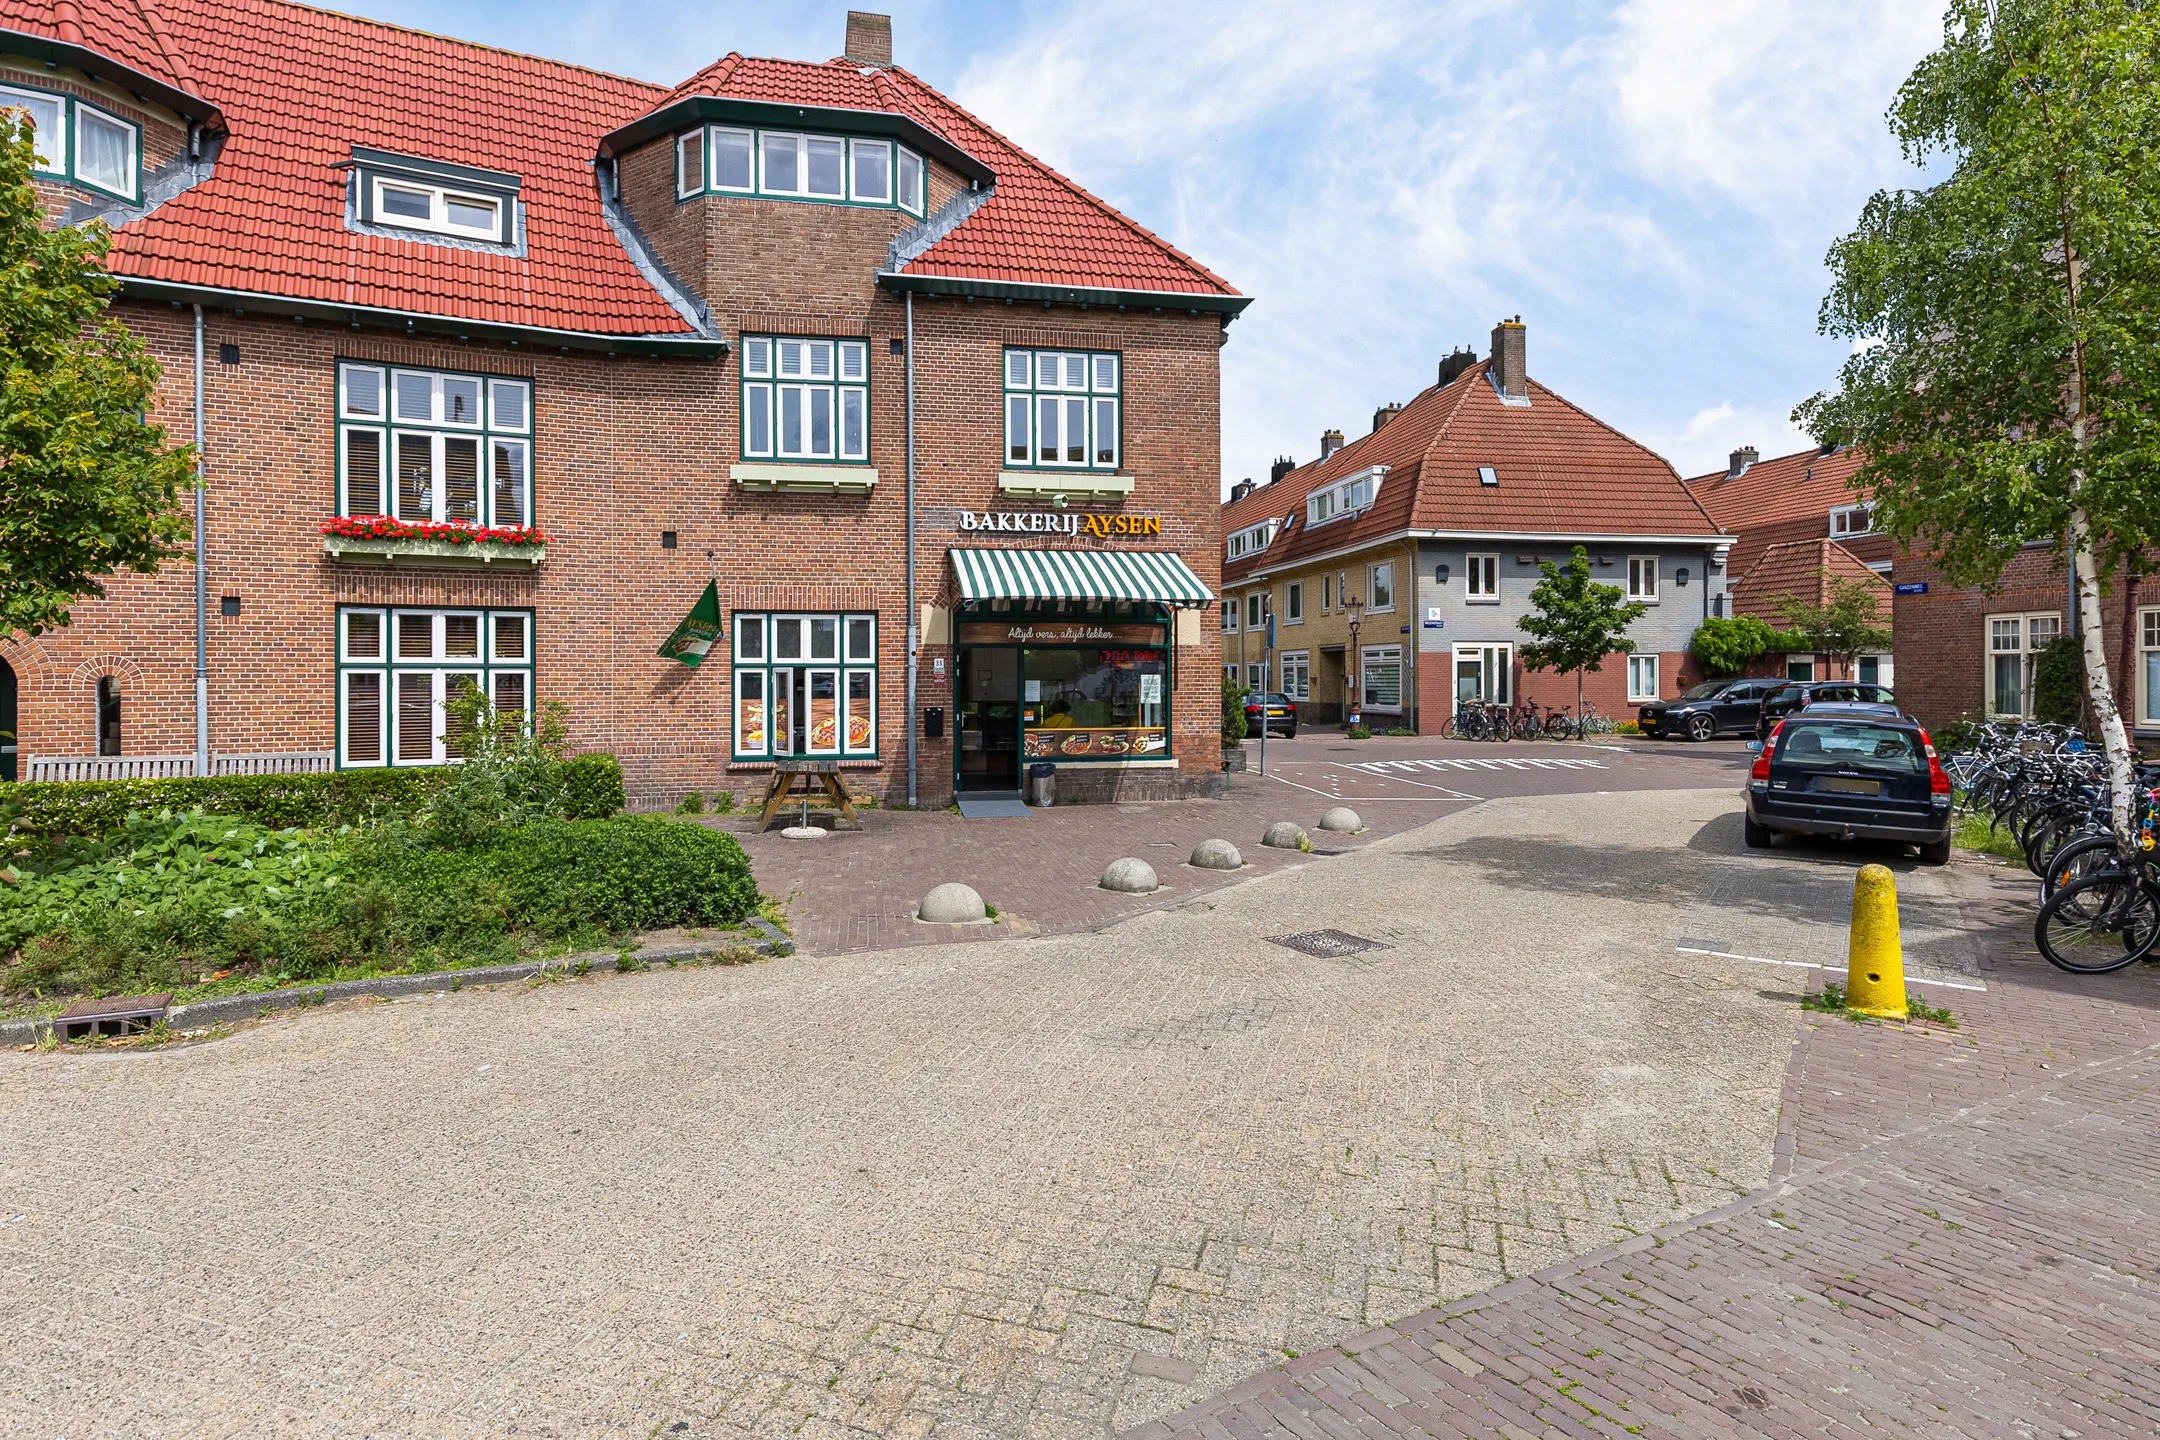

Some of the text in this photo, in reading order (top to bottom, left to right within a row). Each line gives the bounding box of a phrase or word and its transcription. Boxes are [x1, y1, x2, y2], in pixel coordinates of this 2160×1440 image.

[960, 511, 1161, 538] BAKKERIJ AYSEN
[1008, 626, 1034, 643] Altijd
[1035, 631, 1059, 640] vers,
[1060, 627, 1085, 643] altijd
[1106, 651, 1130, 661] PIZZA
